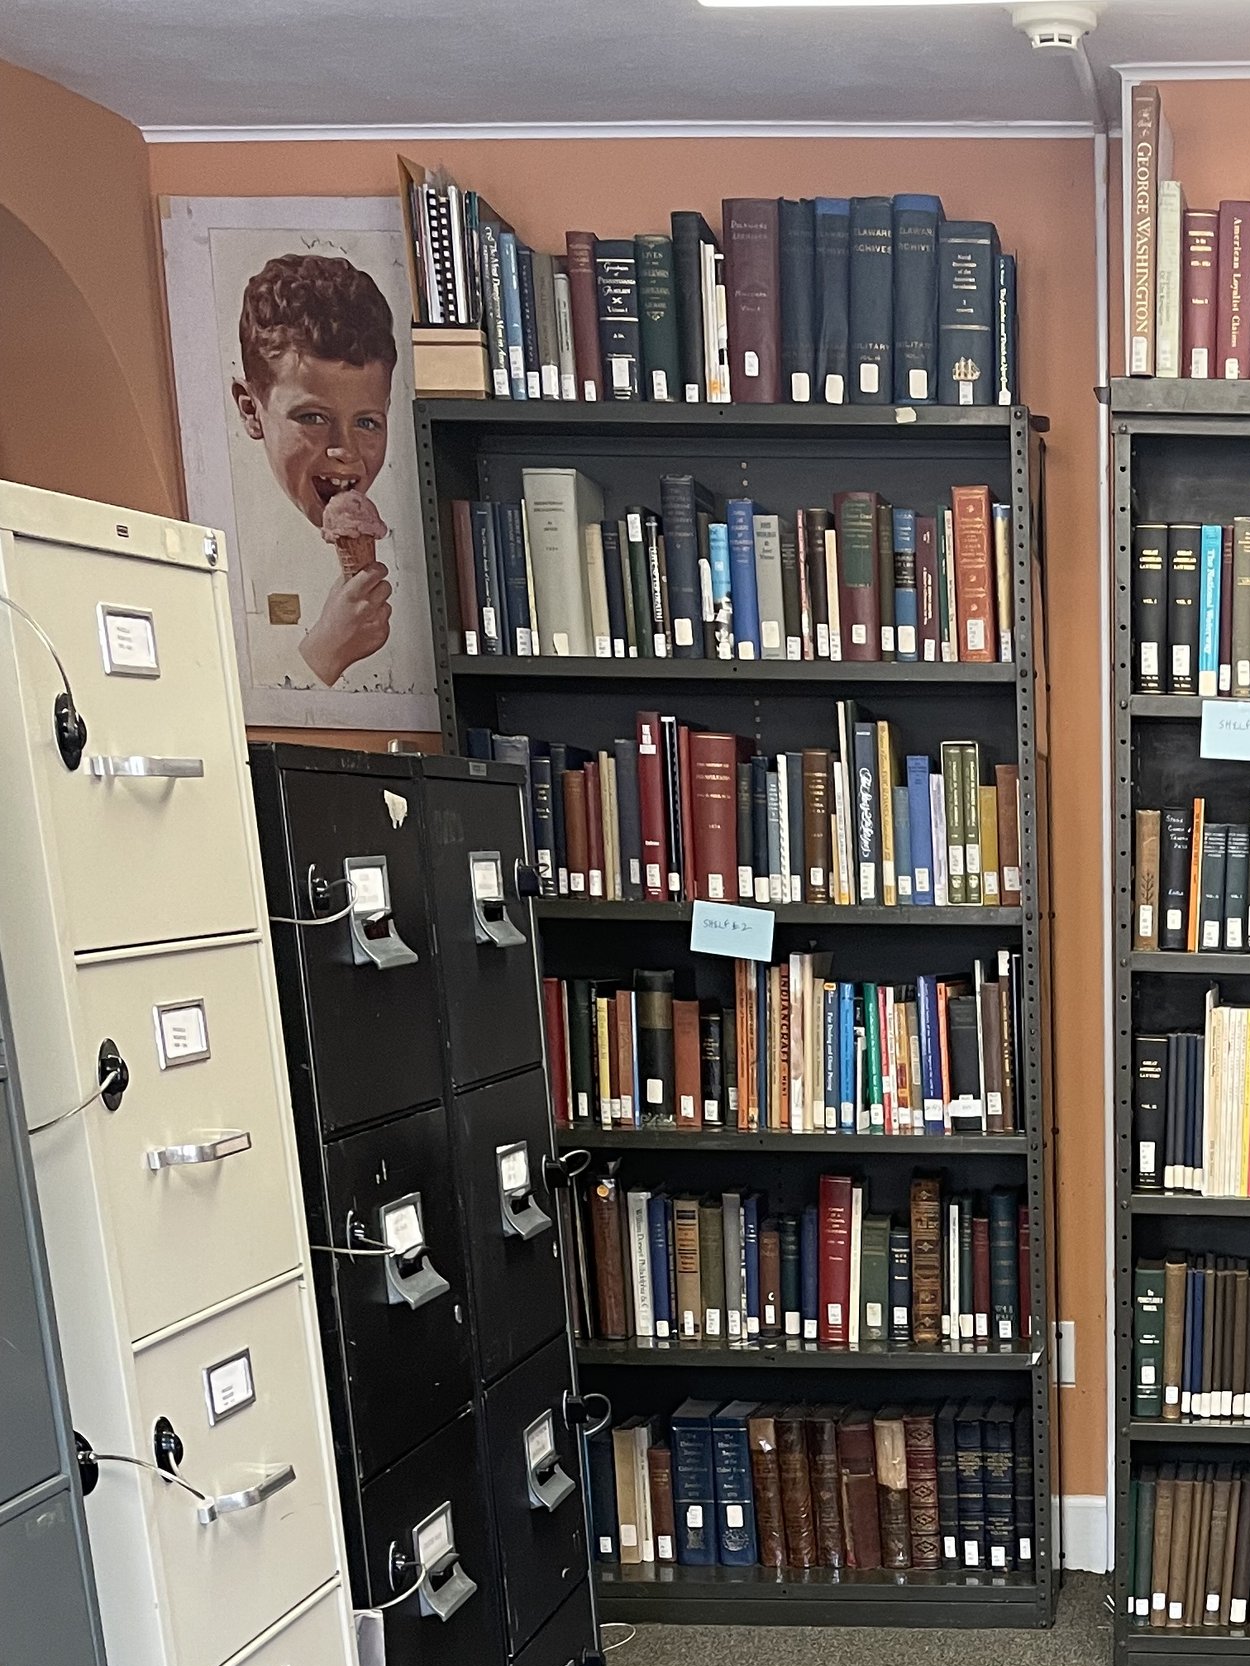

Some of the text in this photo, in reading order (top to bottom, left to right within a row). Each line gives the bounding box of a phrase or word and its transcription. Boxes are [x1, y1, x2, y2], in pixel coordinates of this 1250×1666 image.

[1136, 142, 1152, 214] GEORGE
[1135, 217, 1151, 333] WASHINGTON
[1229, 217, 1243, 348] American Loyalist Claims
[703, 918, 730, 929] SHELF
